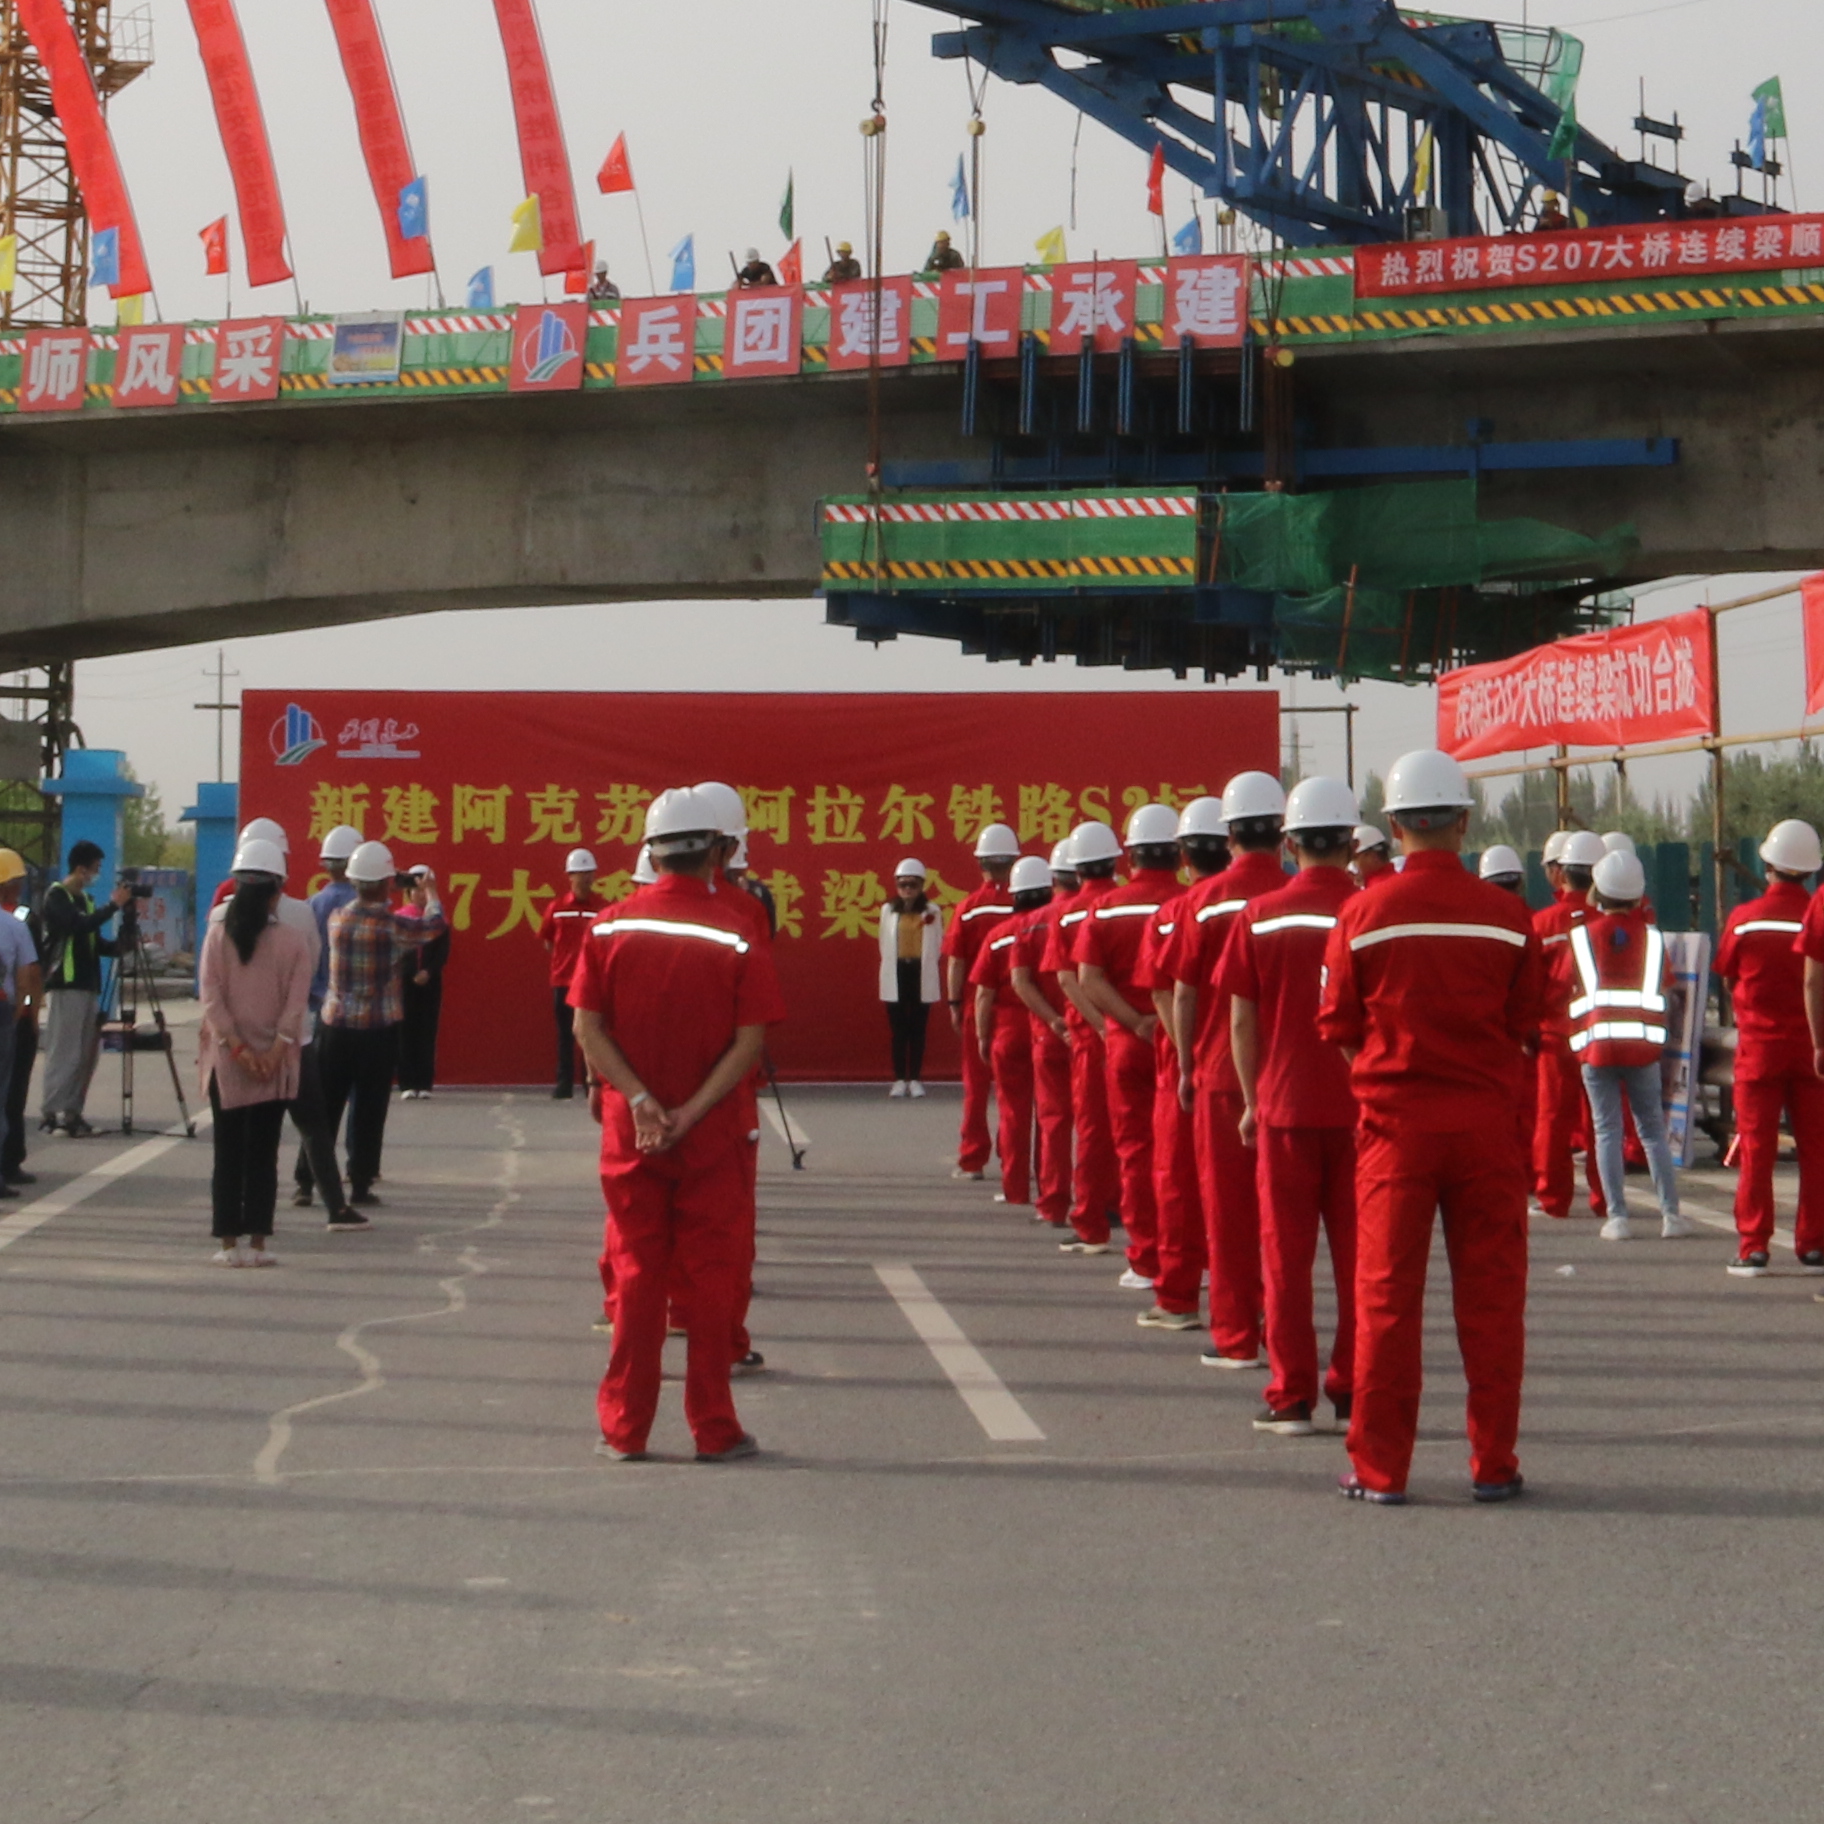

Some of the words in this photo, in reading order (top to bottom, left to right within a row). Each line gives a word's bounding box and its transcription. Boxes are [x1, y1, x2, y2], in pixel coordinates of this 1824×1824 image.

[625, 264, 1241, 373] 兵团建工承建
[1454, 637, 1697, 741] 庆祝S207大桥连续梁成功合拢
